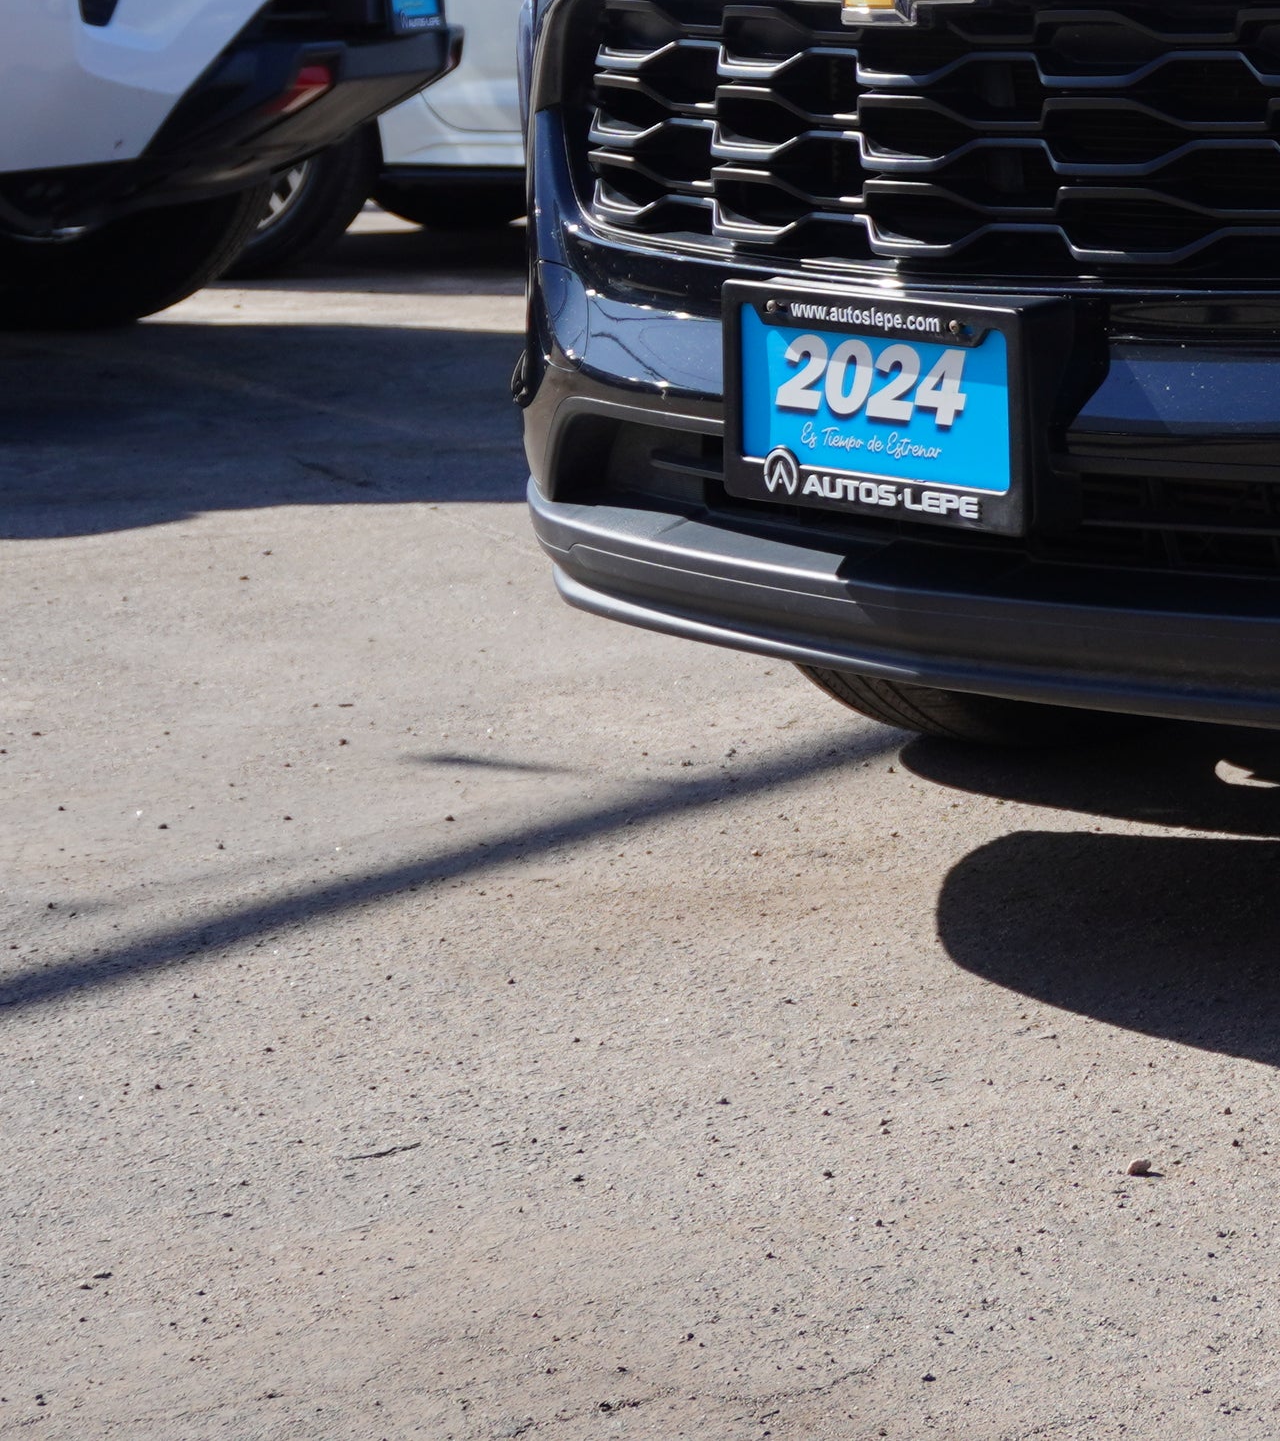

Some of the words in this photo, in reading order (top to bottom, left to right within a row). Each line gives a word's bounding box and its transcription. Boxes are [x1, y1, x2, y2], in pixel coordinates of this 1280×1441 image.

[790, 302, 941, 333] www.autoslepe.com
[775, 334, 967, 426] 2024
[800, 421, 818, 449] Es
[821, 426, 864, 452] Tiempo
[867, 434, 884, 452] de
[886, 431, 942, 460] Estrenar
